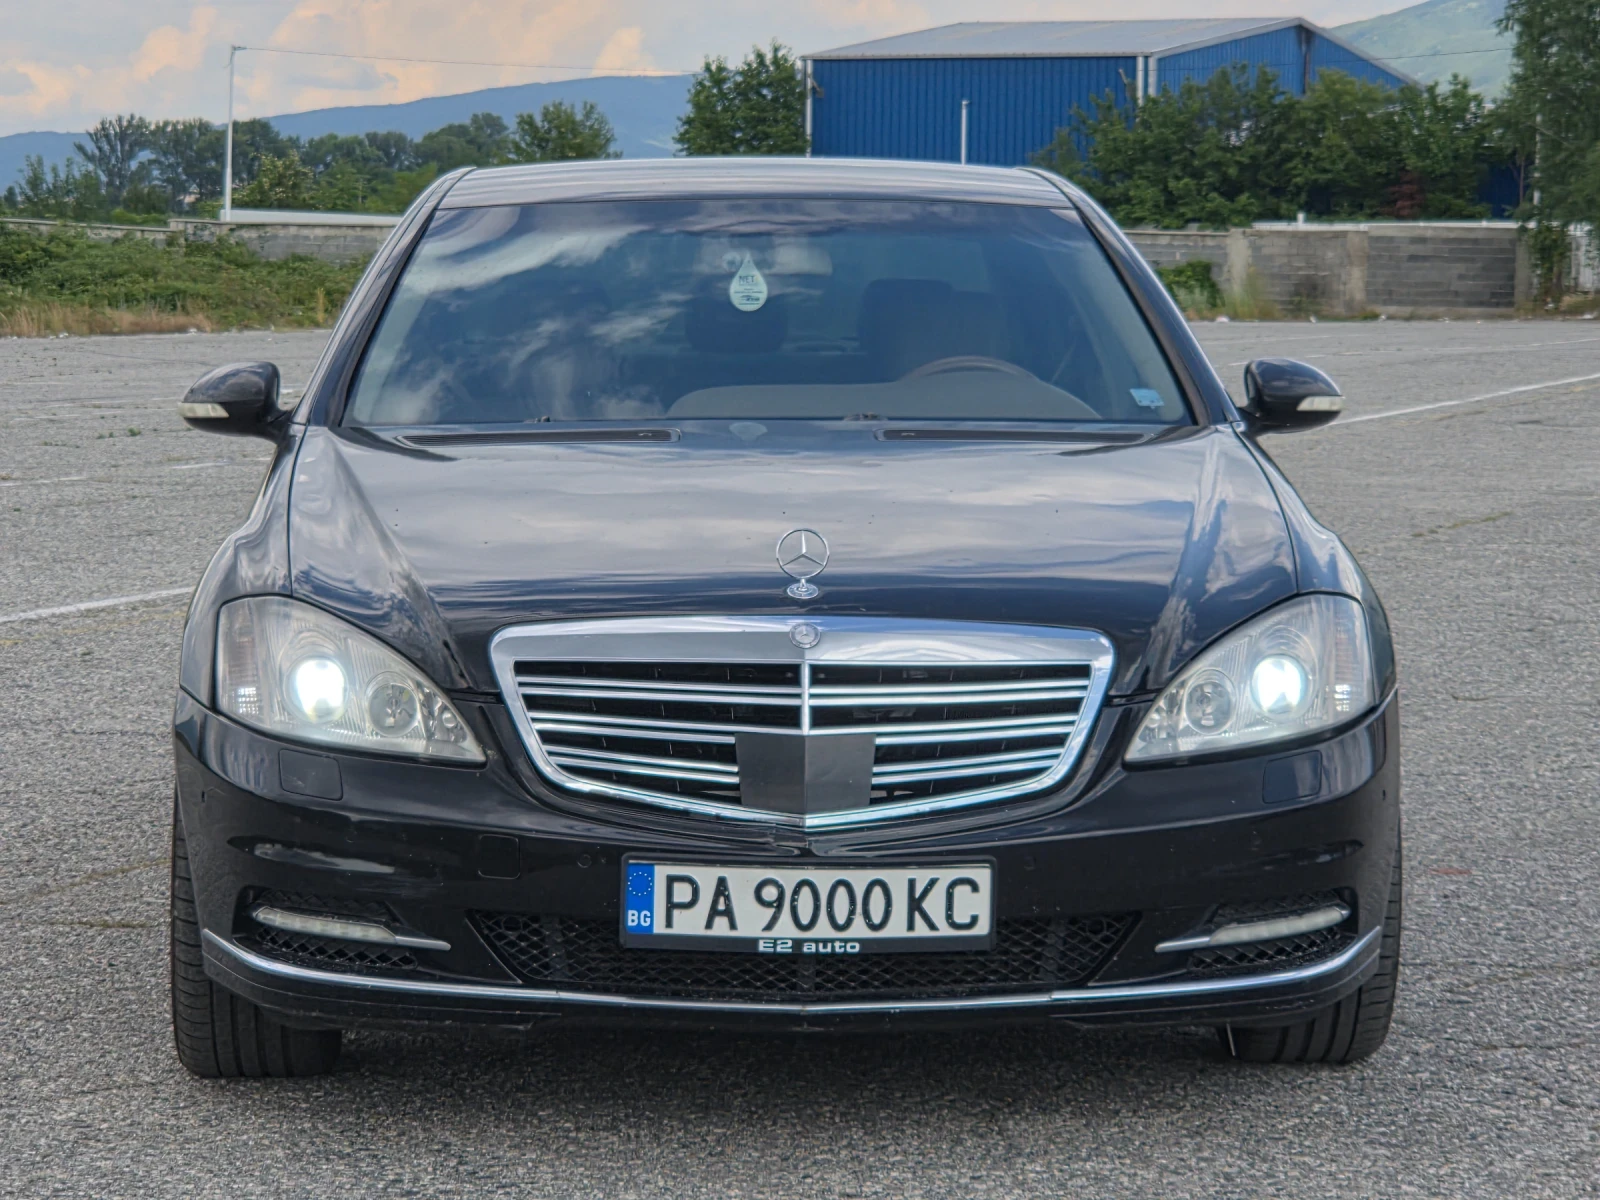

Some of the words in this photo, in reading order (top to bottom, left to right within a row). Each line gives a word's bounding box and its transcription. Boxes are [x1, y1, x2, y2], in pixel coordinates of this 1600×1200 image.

[664, 874, 738, 931] PA
[753, 877, 893, 933] 9000
[906, 877, 980, 933] KC
[627, 910, 651, 927] BG
[757, 939, 793, 953] E2
[802, 940, 861, 954] auto
